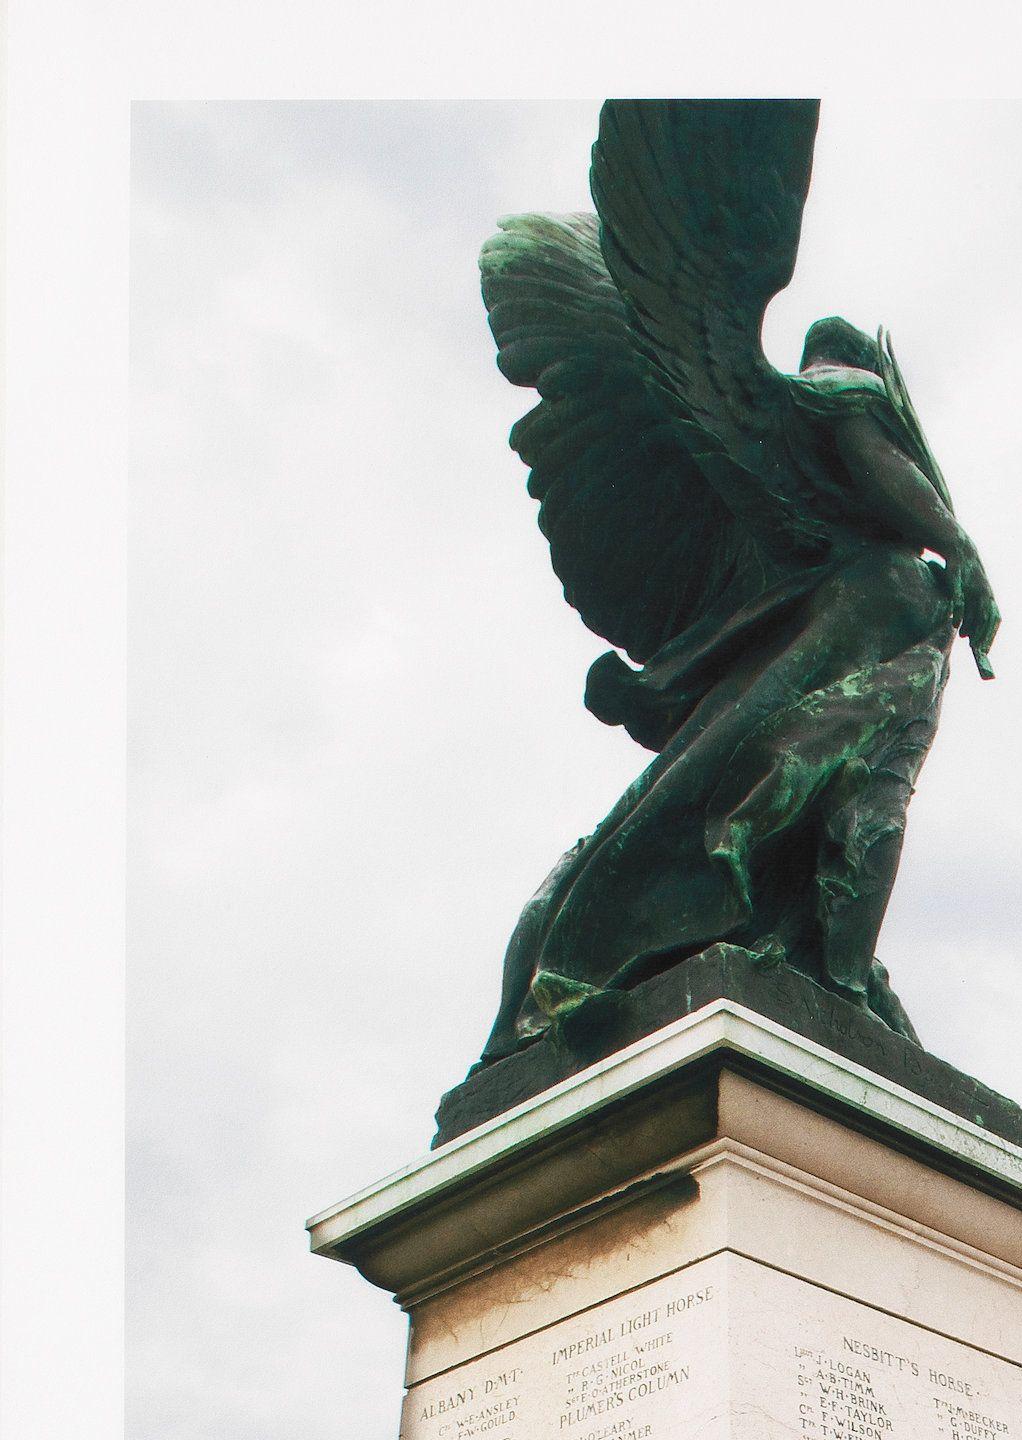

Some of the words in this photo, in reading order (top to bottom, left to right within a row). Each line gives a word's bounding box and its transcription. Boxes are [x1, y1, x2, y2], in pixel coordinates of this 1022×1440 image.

[552, 1328, 615, 1366] IMPERIAL
[620, 1308, 661, 1337] LIGHT
[666, 1286, 714, 1318] HORSE
[634, 1331, 673, 1355] WHITE
[843, 1336, 919, 1377] NESBITT'S
[420, 1388, 474, 1422] ALBANY
[560, 1391, 624, 1430] PLUMER'S
[628, 1365, 690, 1402] COLUMN
